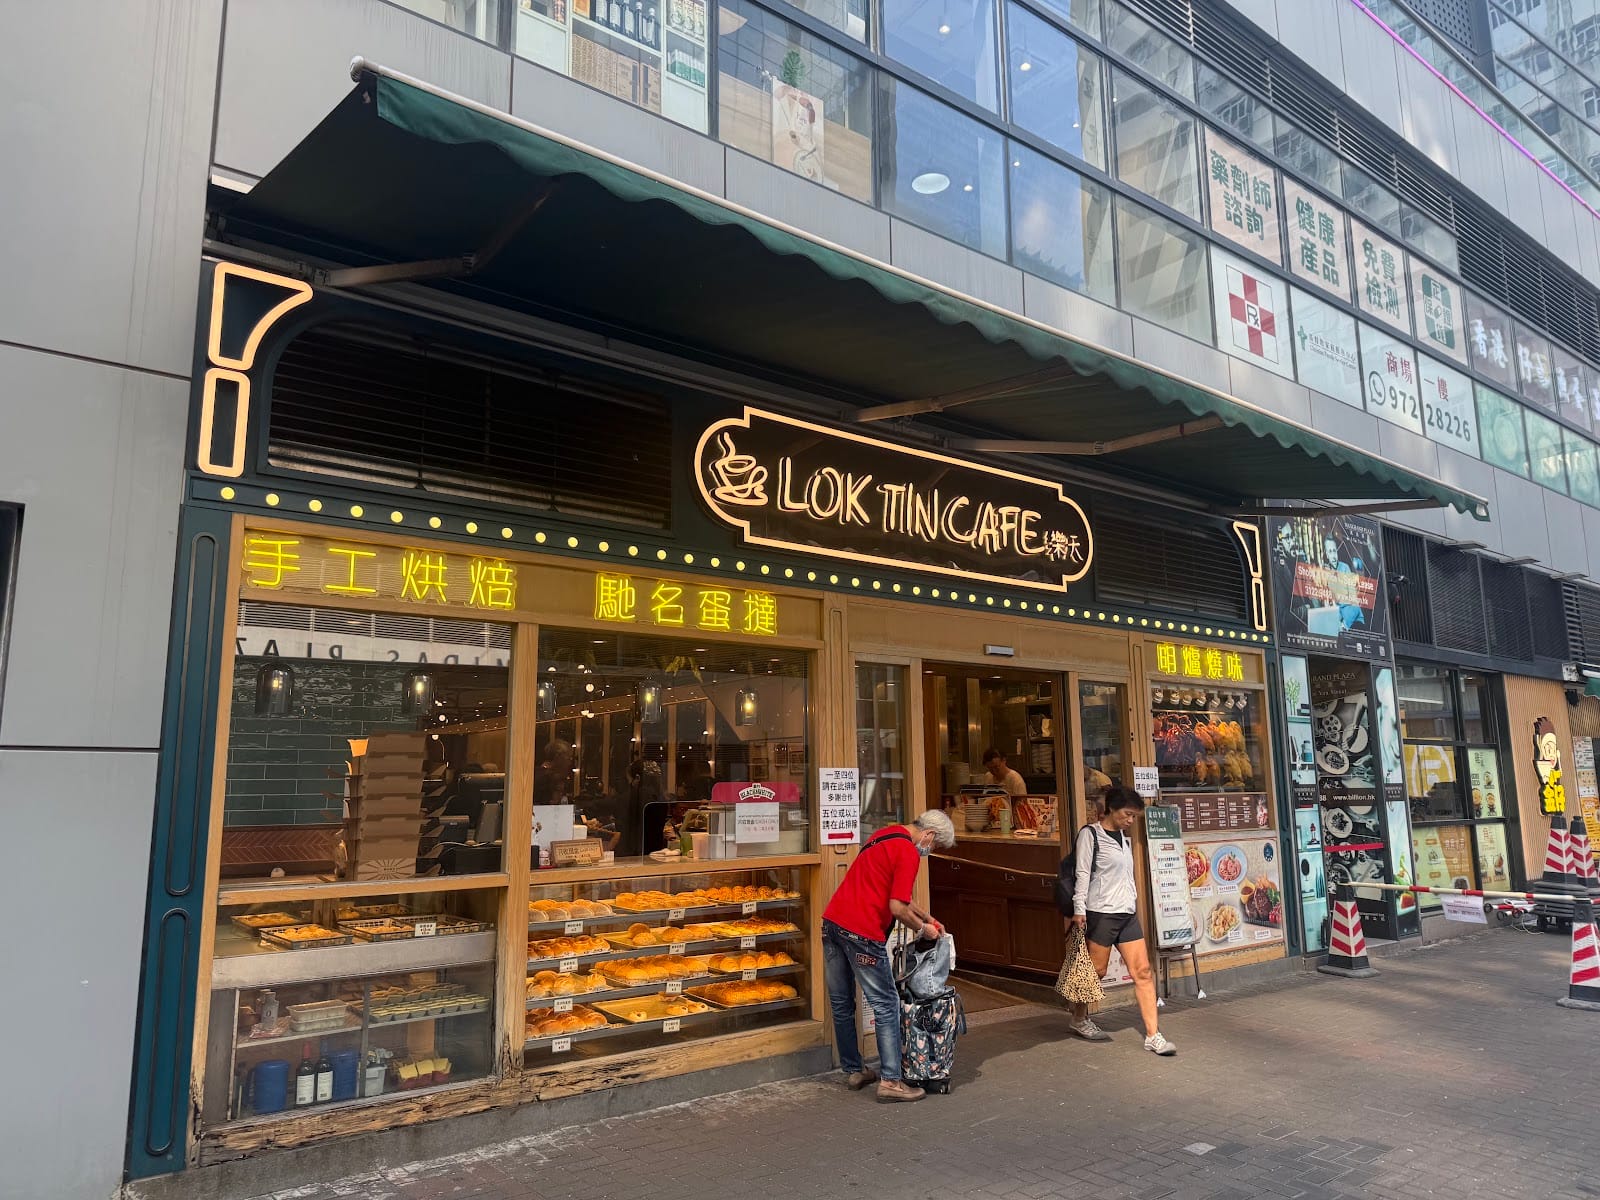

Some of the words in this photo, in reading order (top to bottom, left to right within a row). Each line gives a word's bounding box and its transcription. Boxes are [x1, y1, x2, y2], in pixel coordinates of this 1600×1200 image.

[1210, 149, 1272, 212] 藥劑師
[1296, 196, 1336, 249] 健康
[1362, 238, 1397, 285] 免費
[1386, 351, 1412, 384] 商場
[1424, 376, 1448, 401] 一樓
[1389, 386, 1418, 419] 972
[1426, 403, 1470, 442] 28226
[777, 456, 873, 526] LOK
[877, 482, 939, 542] TIN
[942, 496, 1045, 557] CAFE
[246, 539, 514, 607] 手工烘焙
[598, 576, 775, 635] 馳名蛋撻
[1157, 643, 1244, 682] 明爐燒味
[825, 770, 854, 780] 一至四位
[828, 793, 853, 802] 多謝合作
[822, 808, 858, 818] 五位或以上
